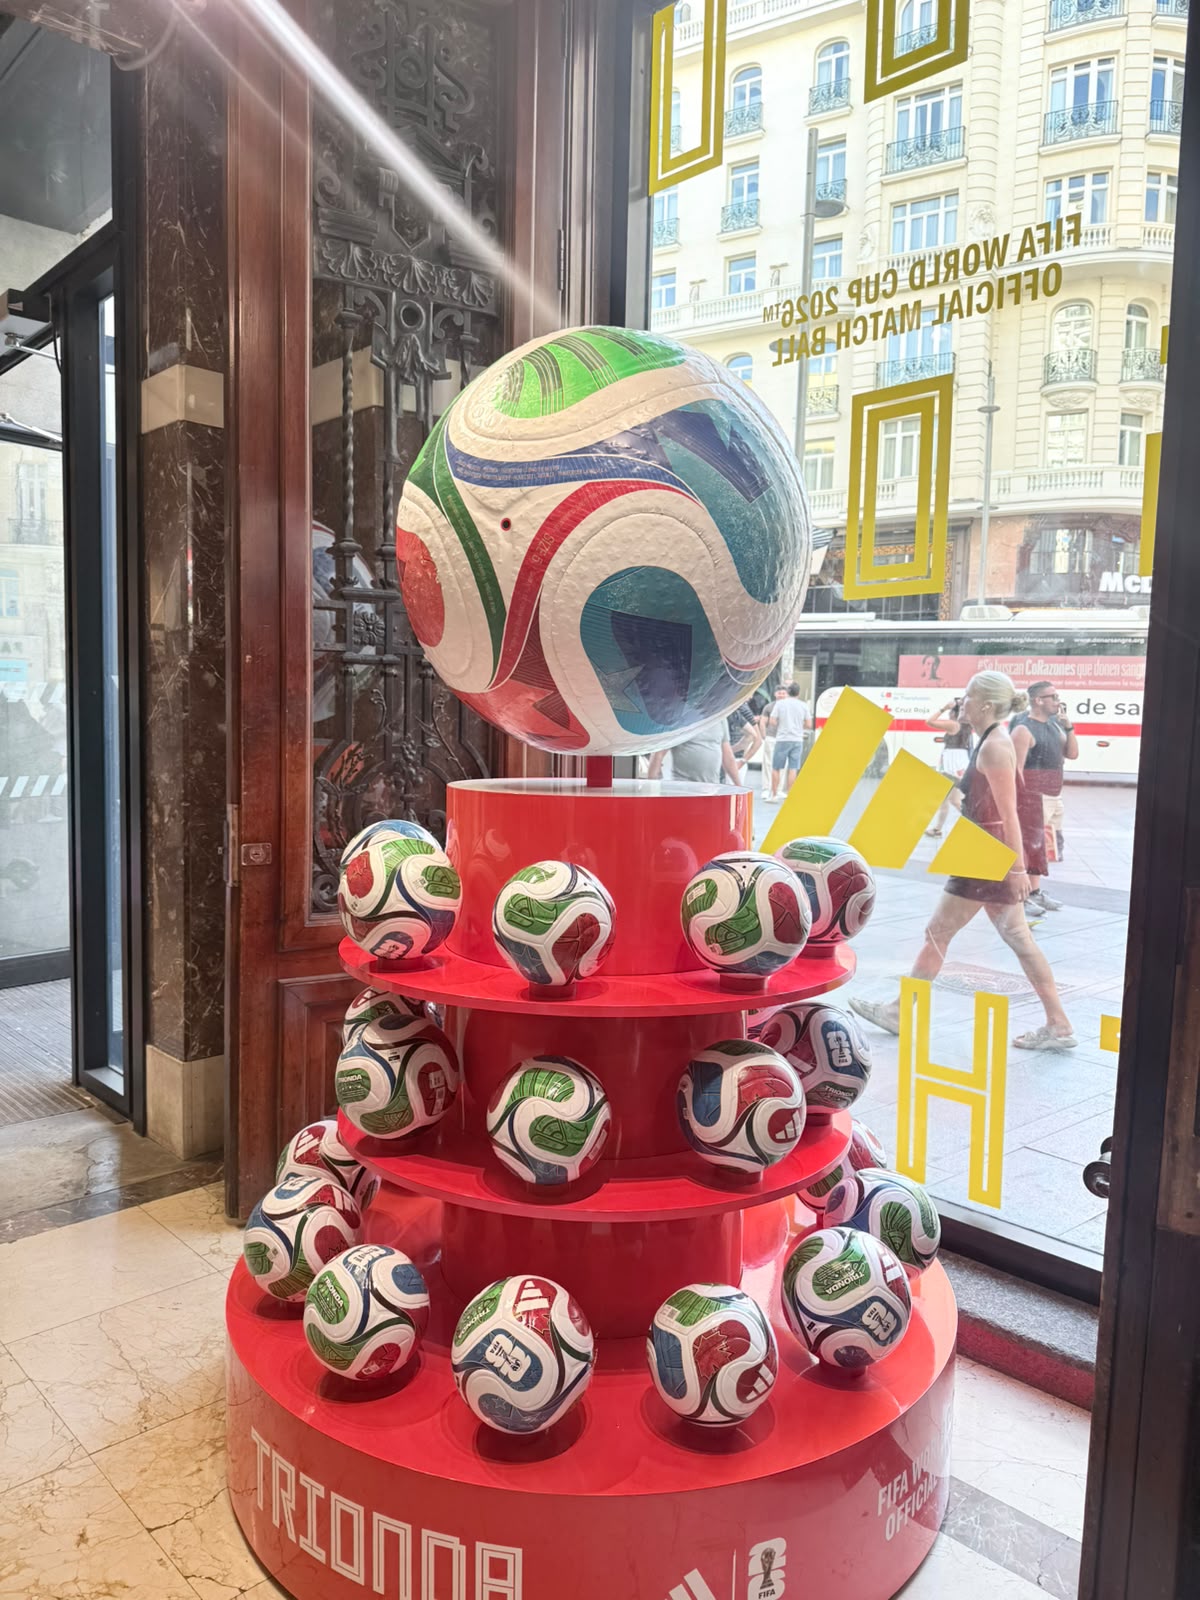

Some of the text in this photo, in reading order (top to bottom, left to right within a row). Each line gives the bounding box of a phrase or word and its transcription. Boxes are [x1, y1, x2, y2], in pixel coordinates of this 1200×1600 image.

[1076, 663, 1093, 679] que
[1093, 658, 1120, 677] donen
[1120, 663, 1145, 680] sang
[913, 706, 930, 714] Roja
[1076, 697, 1106, 715] de
[323, 1275, 344, 1308] TRIONDA
[823, 1270, 865, 1295] TRIONDA
[877, 1468, 909, 1517] FIFA
[757, 1588, 776, 1600] FIFA
